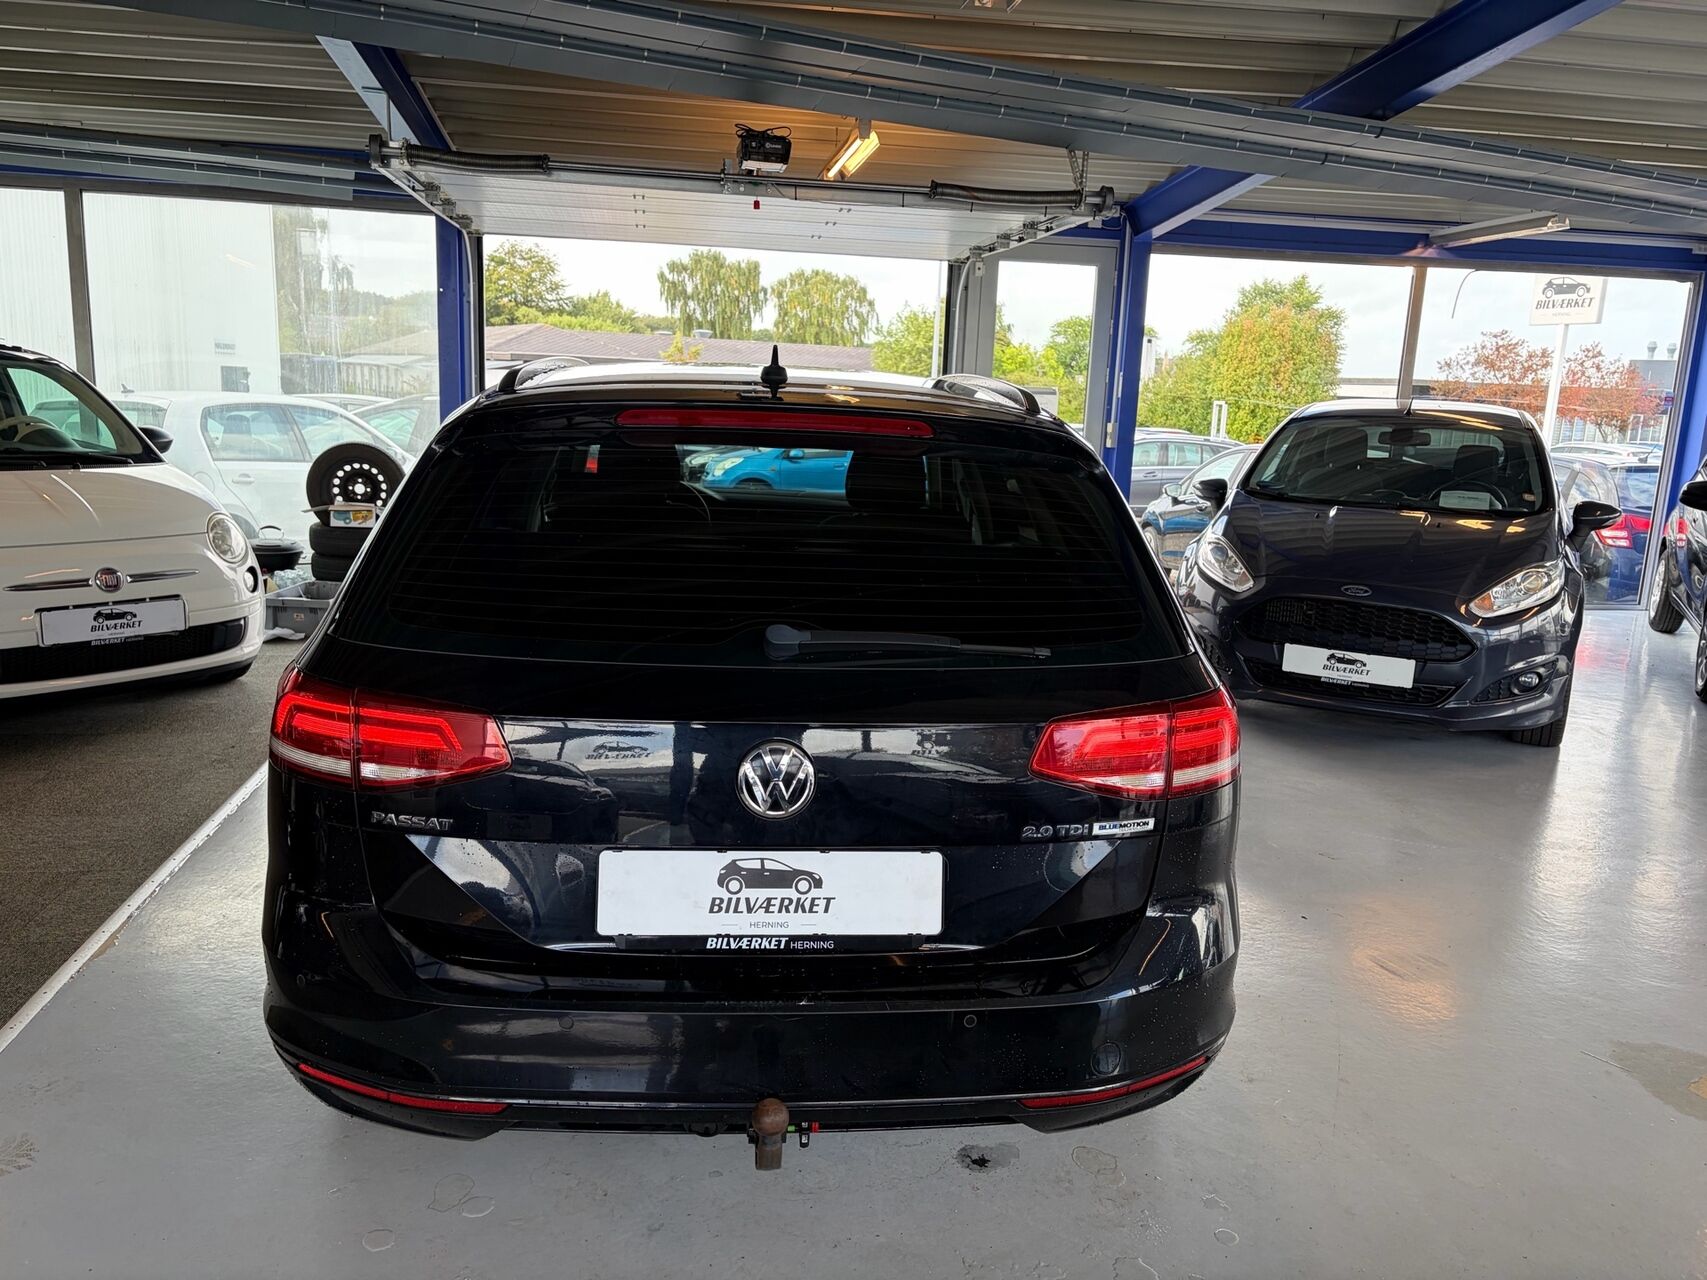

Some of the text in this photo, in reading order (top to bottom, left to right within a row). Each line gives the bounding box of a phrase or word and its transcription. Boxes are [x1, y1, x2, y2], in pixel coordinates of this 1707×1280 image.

[1535, 297, 1595, 310] BILVÆRKET
[90, 620, 143, 632] BILVÆRKET
[1322, 663, 1371, 676] BILVÆRKET
[370, 810, 453, 831] PASSAT
[1022, 825, 1054, 838] 2.0
[1056, 824, 1089, 837] TDI
[1098, 820, 1150, 831] BLUEMOTION
[708, 896, 836, 914] BILVÆRKET
[749, 921, 790, 929] HERNING
[706, 937, 834, 949] BILVÆRKET HERNING
